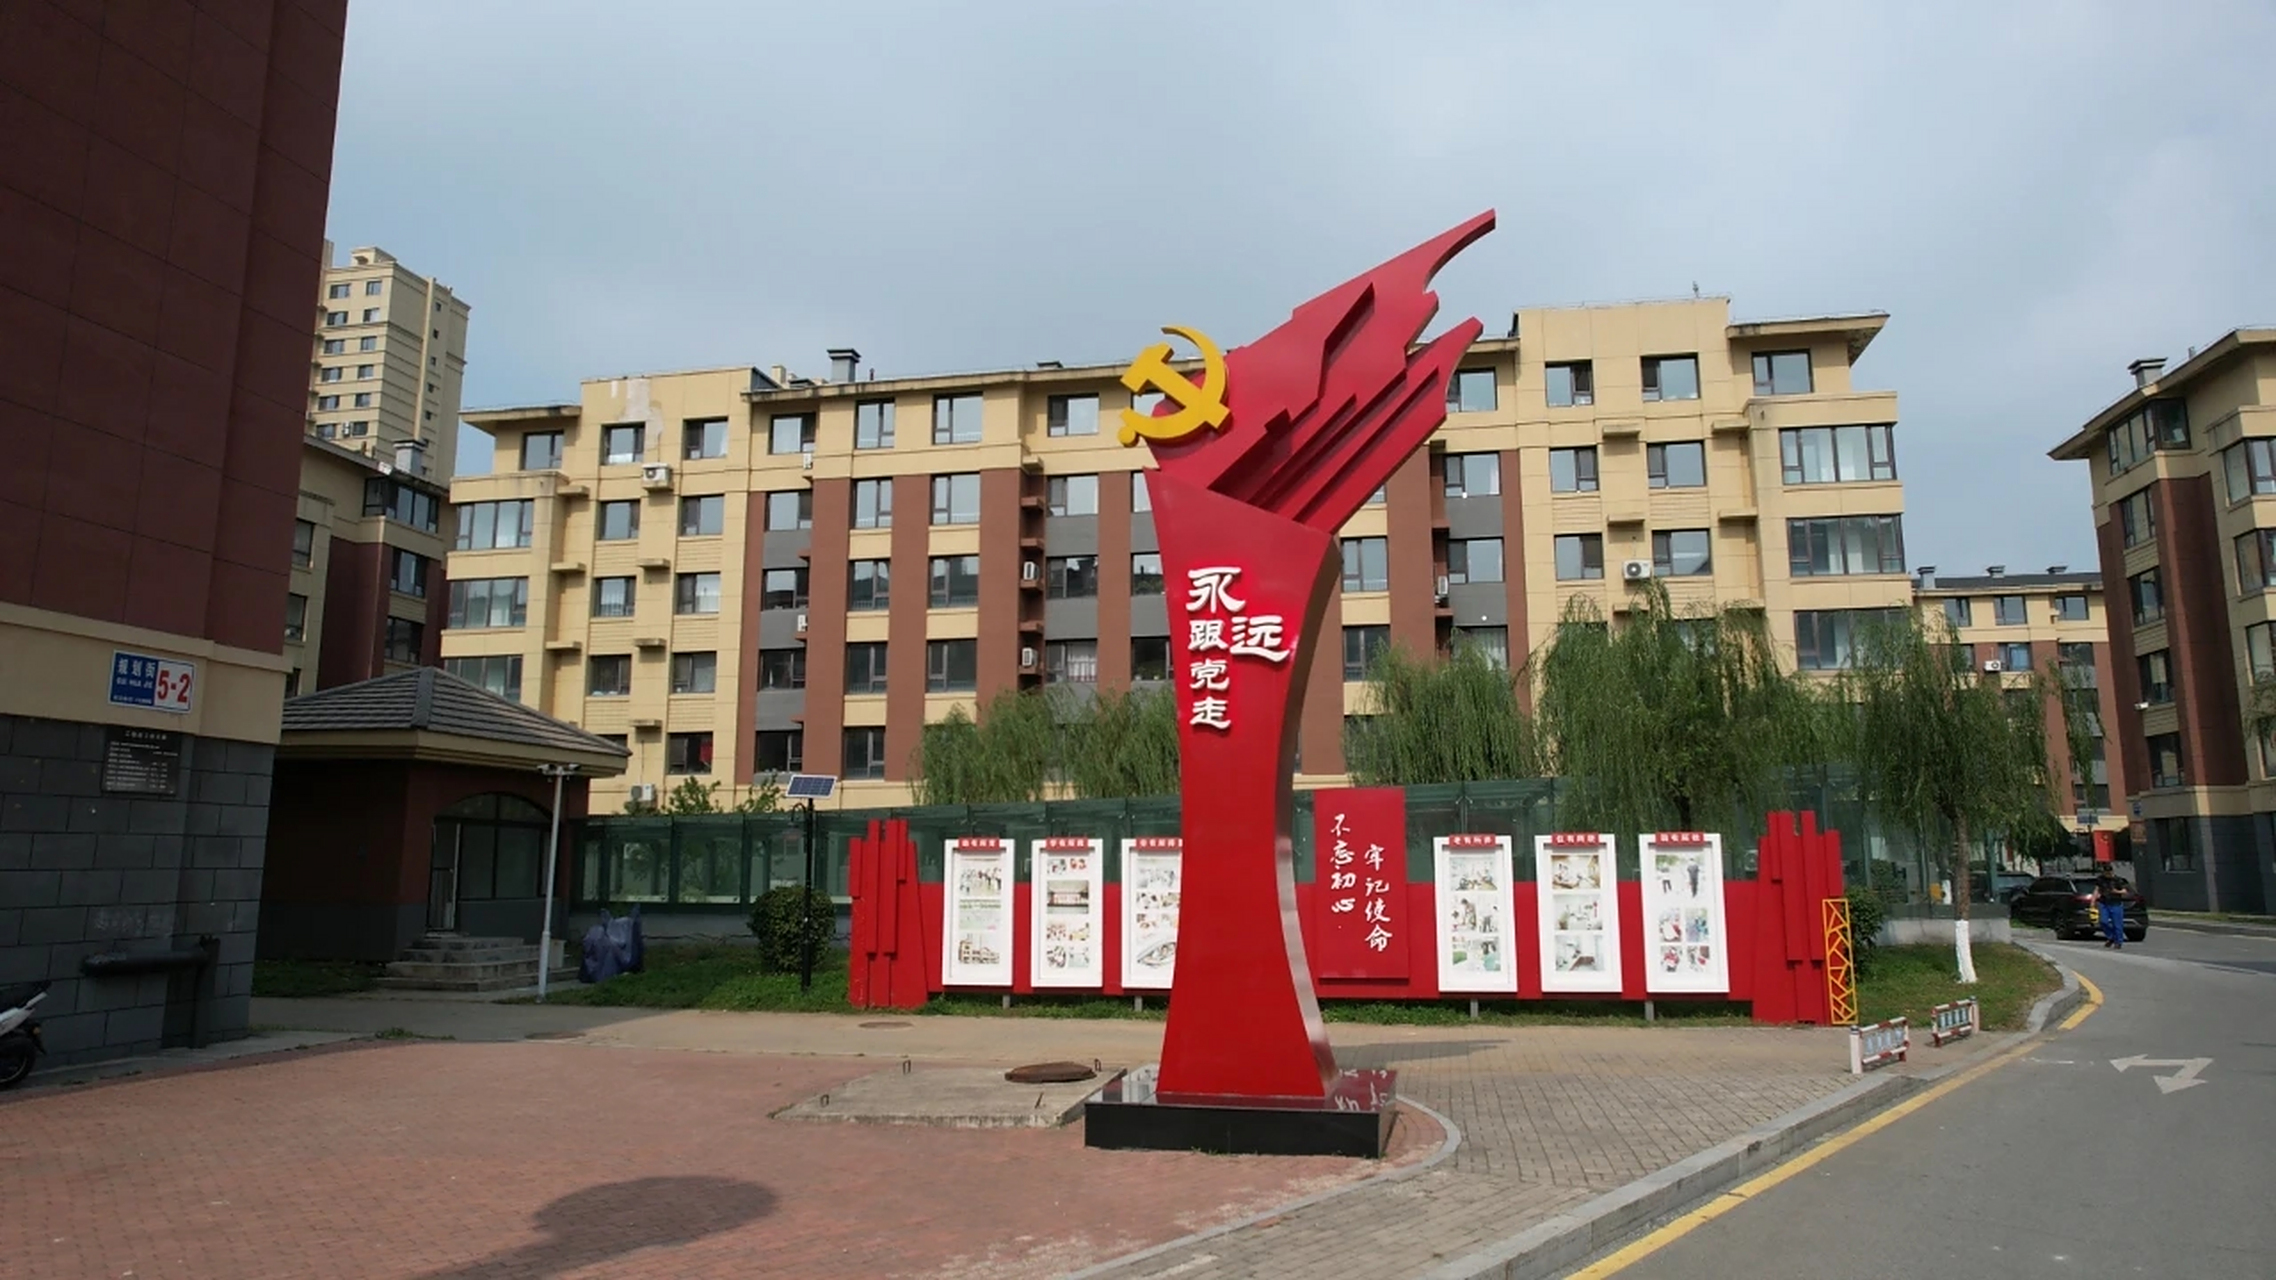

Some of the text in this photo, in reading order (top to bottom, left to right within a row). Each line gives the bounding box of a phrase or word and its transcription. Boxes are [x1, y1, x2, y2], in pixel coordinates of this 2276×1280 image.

[157, 670, 191, 703] 5-2
[1188, 619, 1231, 730] 跟党走
[1330, 813, 1357, 914] 不忘初心
[1364, 843, 1393, 952] 牢记使命
